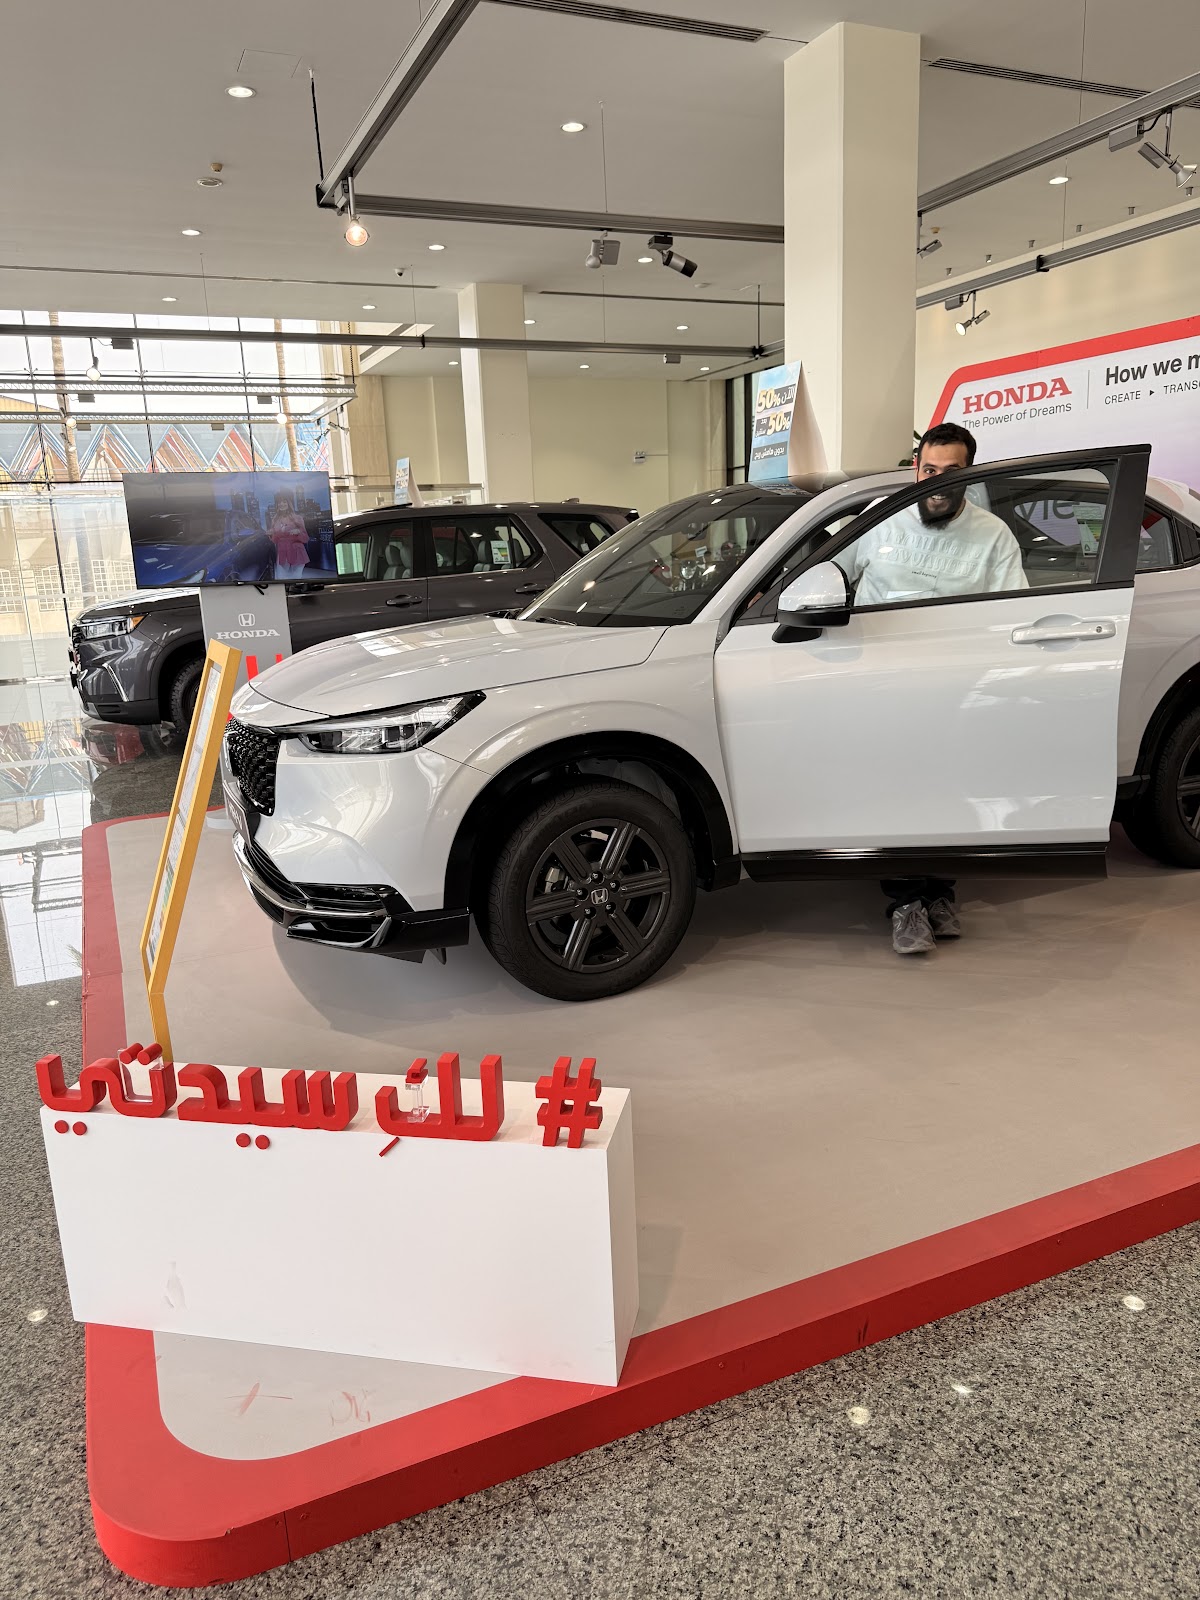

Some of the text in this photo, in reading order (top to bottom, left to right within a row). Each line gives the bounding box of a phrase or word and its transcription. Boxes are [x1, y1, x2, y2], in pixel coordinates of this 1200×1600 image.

[1105, 365, 1148, 386] How
[1152, 358, 1183, 376] we
[962, 377, 1073, 415] HONDA
[1104, 379, 1200, 405] CREATE TRANS
[962, 402, 1072, 430] The Power of Dreams
[216, 628, 280, 640] HONDA
[35, 1042, 359, 1151] سيدتي
[535, 1056, 604, 1149] #
